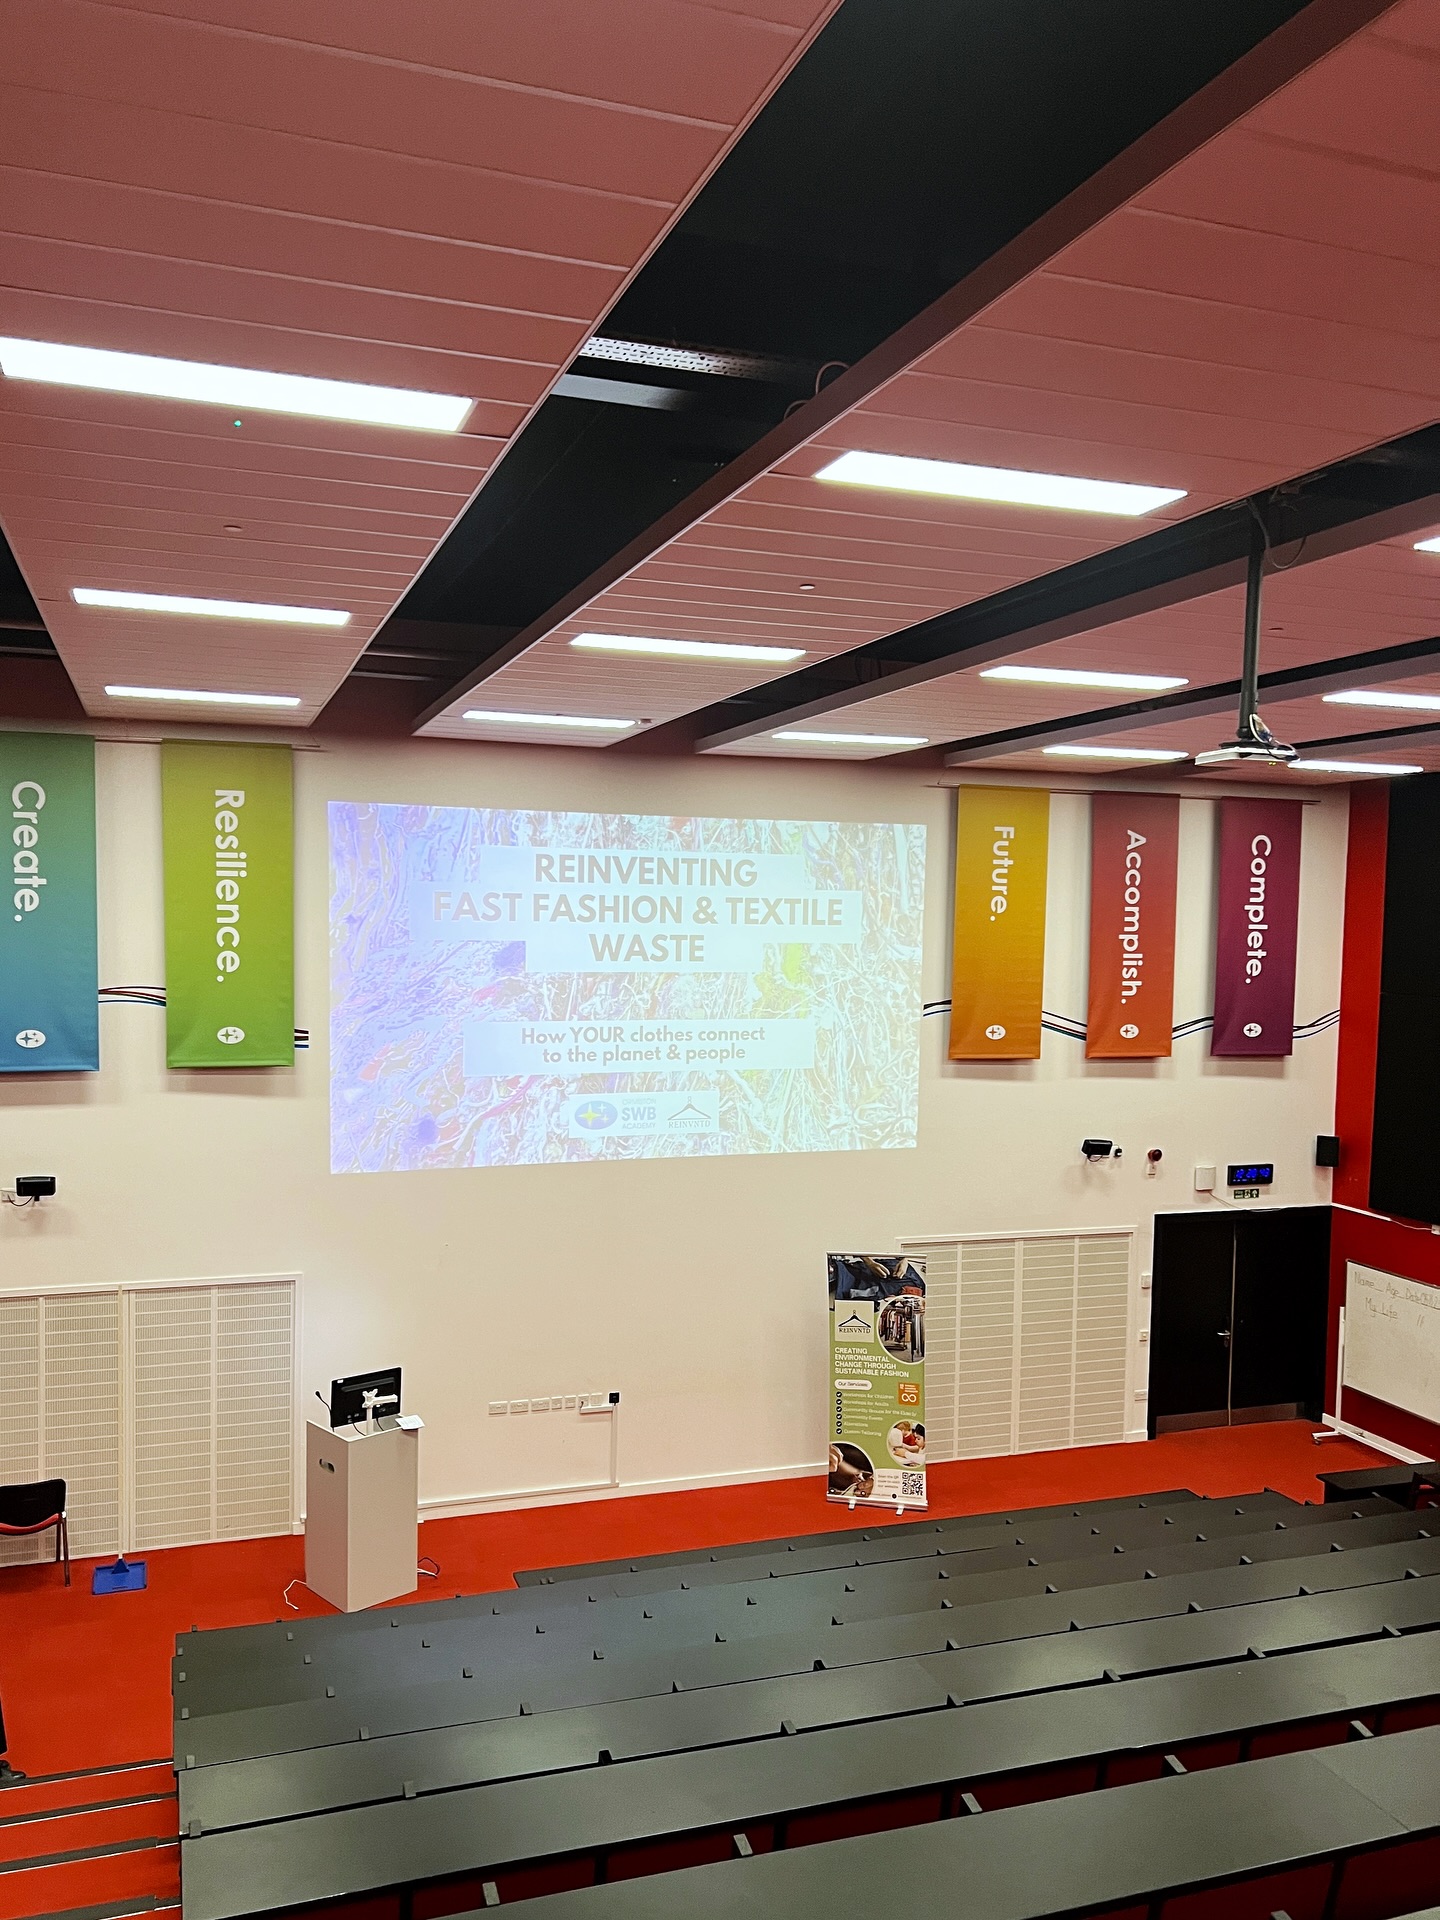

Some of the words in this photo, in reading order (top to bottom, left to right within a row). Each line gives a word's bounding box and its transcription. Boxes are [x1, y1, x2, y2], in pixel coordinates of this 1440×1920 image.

[12, 781, 47, 922] Create.
[214, 789, 247, 982] Resilience.
[534, 853, 759, 888] REINVENTING
[990, 826, 1015, 922] Future.
[433, 891, 523, 922] FAST
[532, 892, 684, 924] FASHION
[692, 896, 718, 926] &
[726, 896, 843, 926] TEXTILE
[1118, 829, 1147, 1004] Accomplish.
[1244, 834, 1272, 984] Complete.
[589, 933, 705, 963] WASTE
[521, 1027, 566, 1044] How
[569, 1026, 625, 1044] YOUR
[630, 1025, 693, 1043] clothes
[697, 1026, 766, 1042] connect
[542, 1048, 562, 1063] to
[567, 1045, 597, 1063] the
[602, 1044, 662, 1067] planet
[666, 1043, 682, 1061] &
[685, 1043, 745, 1065] people
[621, 1106, 657, 1122] SWB
[621, 1122, 656, 1130] ACADEMY
[668, 1119, 711, 1129] REINVNTD
[834, 1354, 890, 1362] ENVIRONMENTAL
[834, 1367, 879, 1376] SUSTAINABLE
[880, 1370, 909, 1378] FASHION
